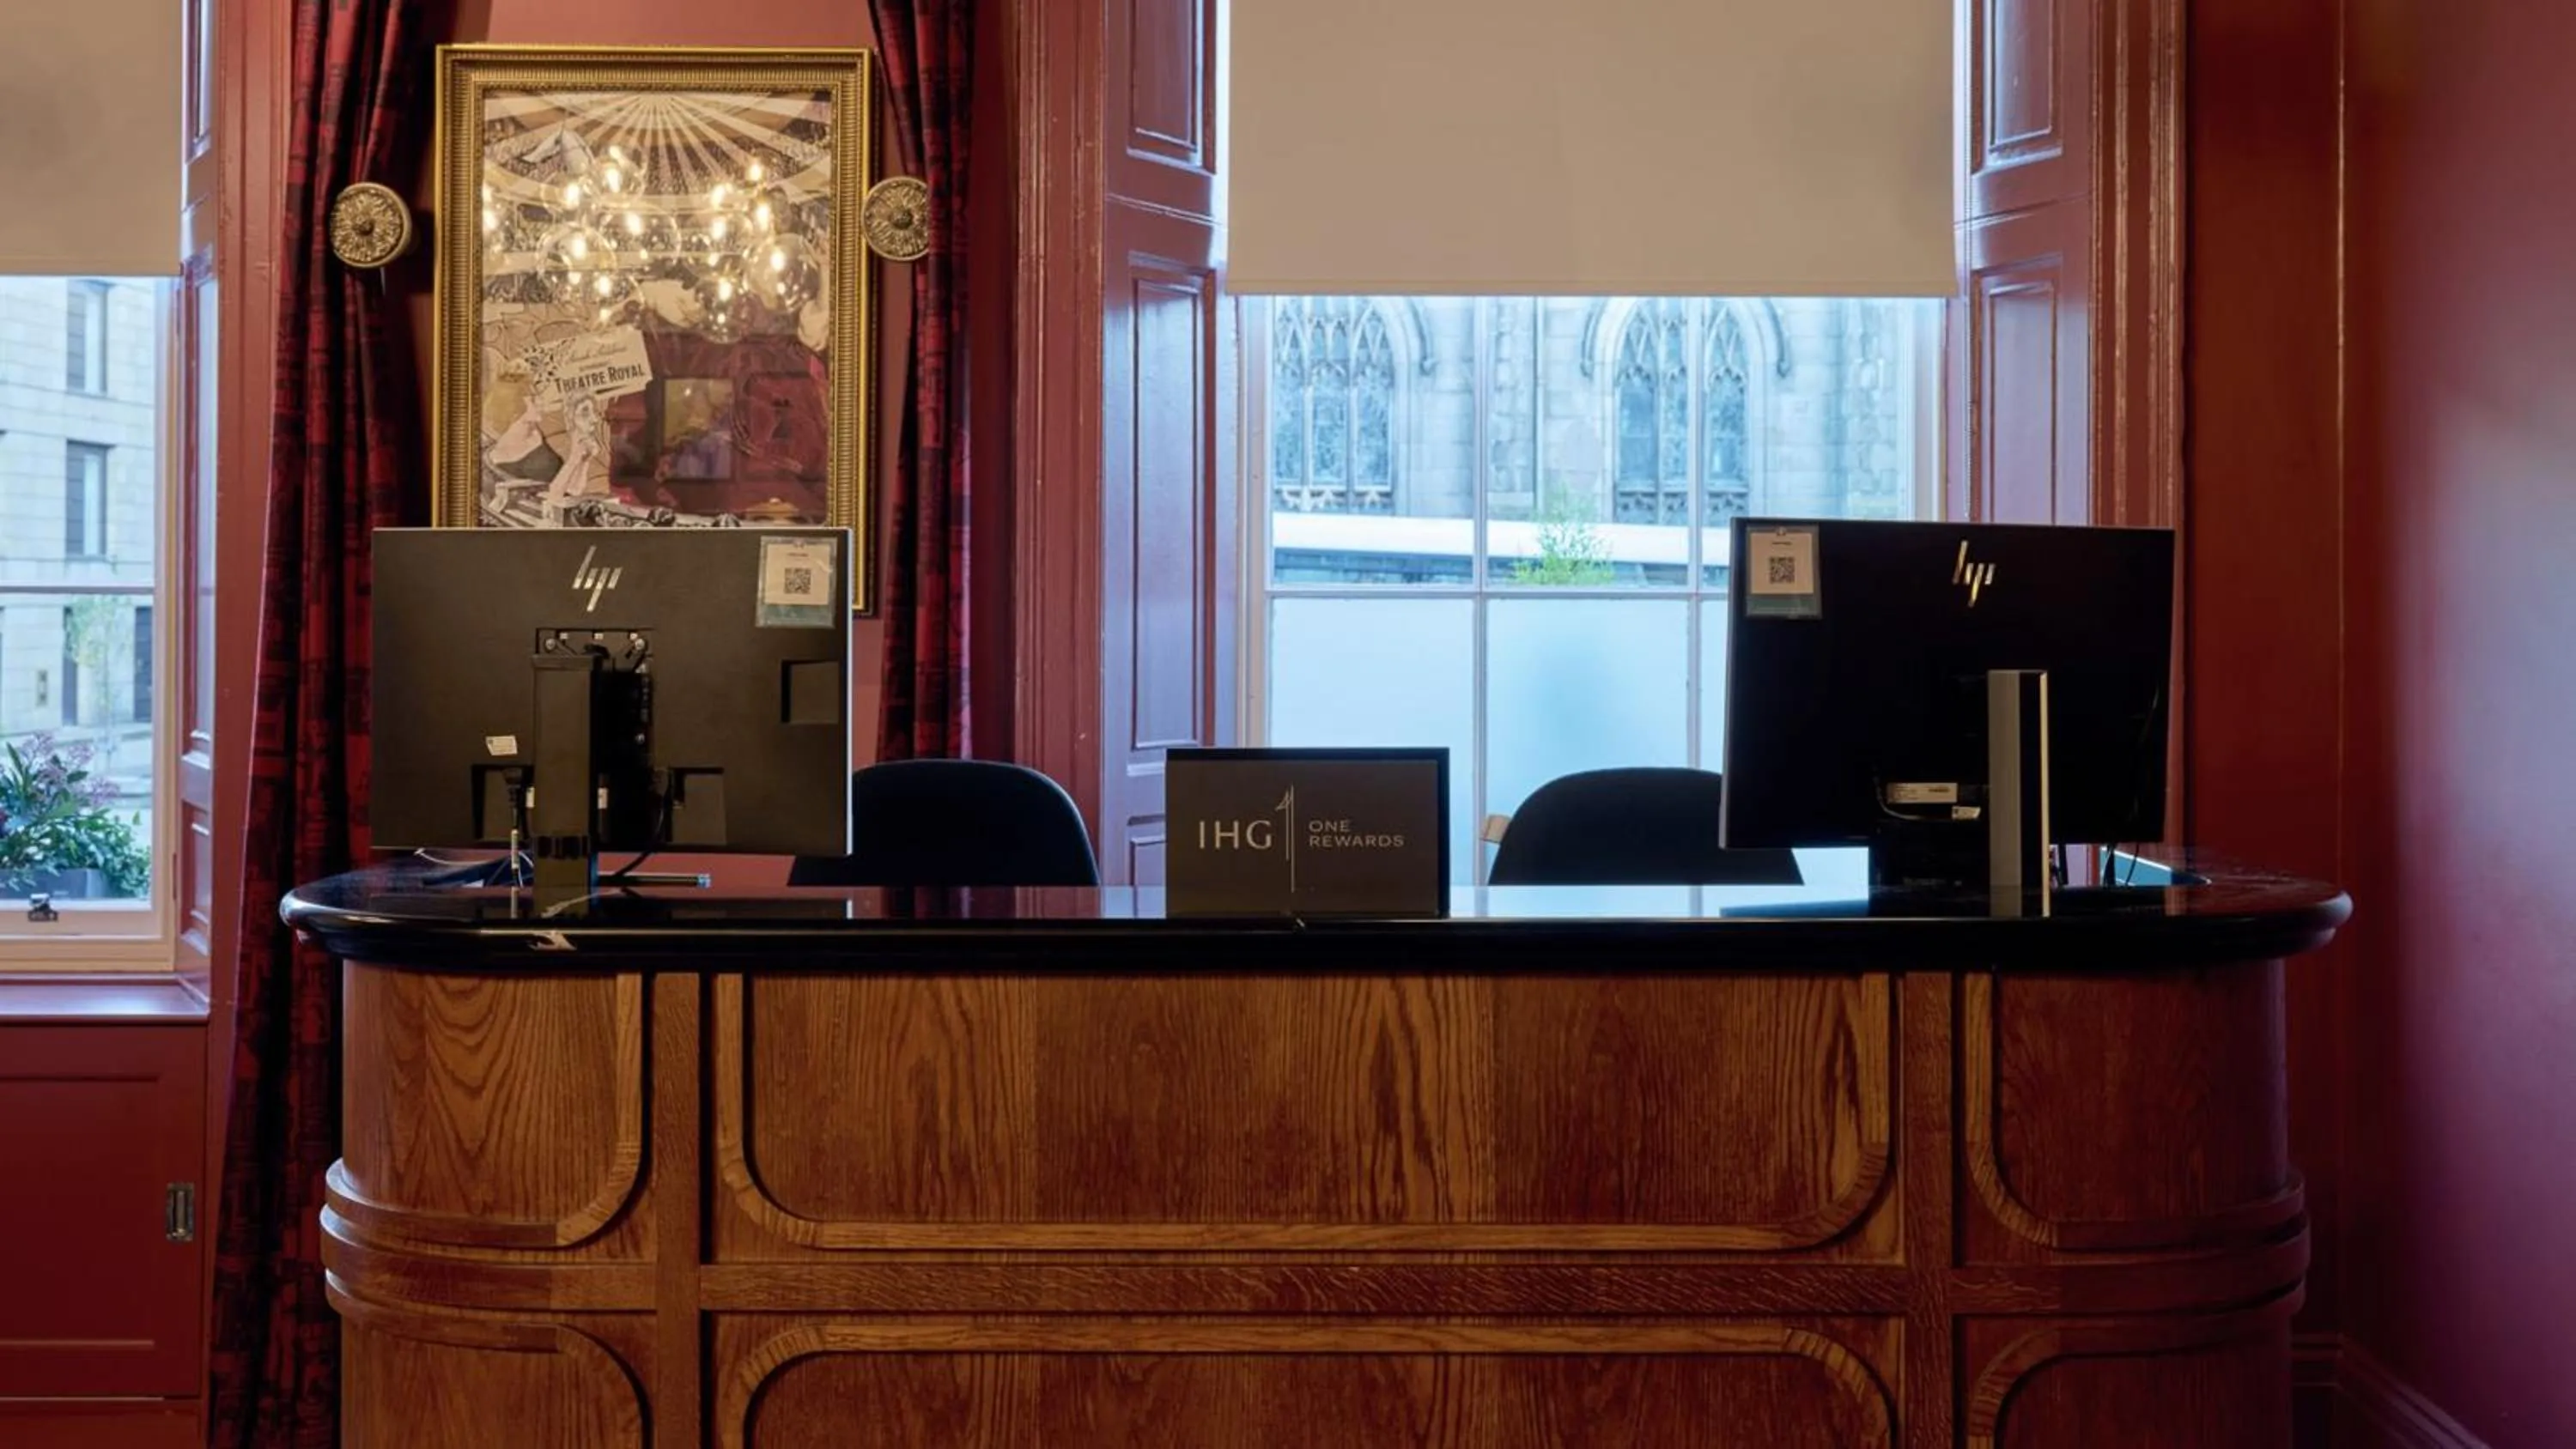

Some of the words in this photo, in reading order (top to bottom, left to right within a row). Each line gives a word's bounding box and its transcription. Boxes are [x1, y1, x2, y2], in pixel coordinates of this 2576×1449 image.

[556, 372, 605, 393] THEATRE
[607, 364, 645, 382] ROYAL
[1199, 820, 1273, 849] IHG
[1309, 820, 1351, 833] ONE
[1309, 835, 1405, 848] REWARDS
